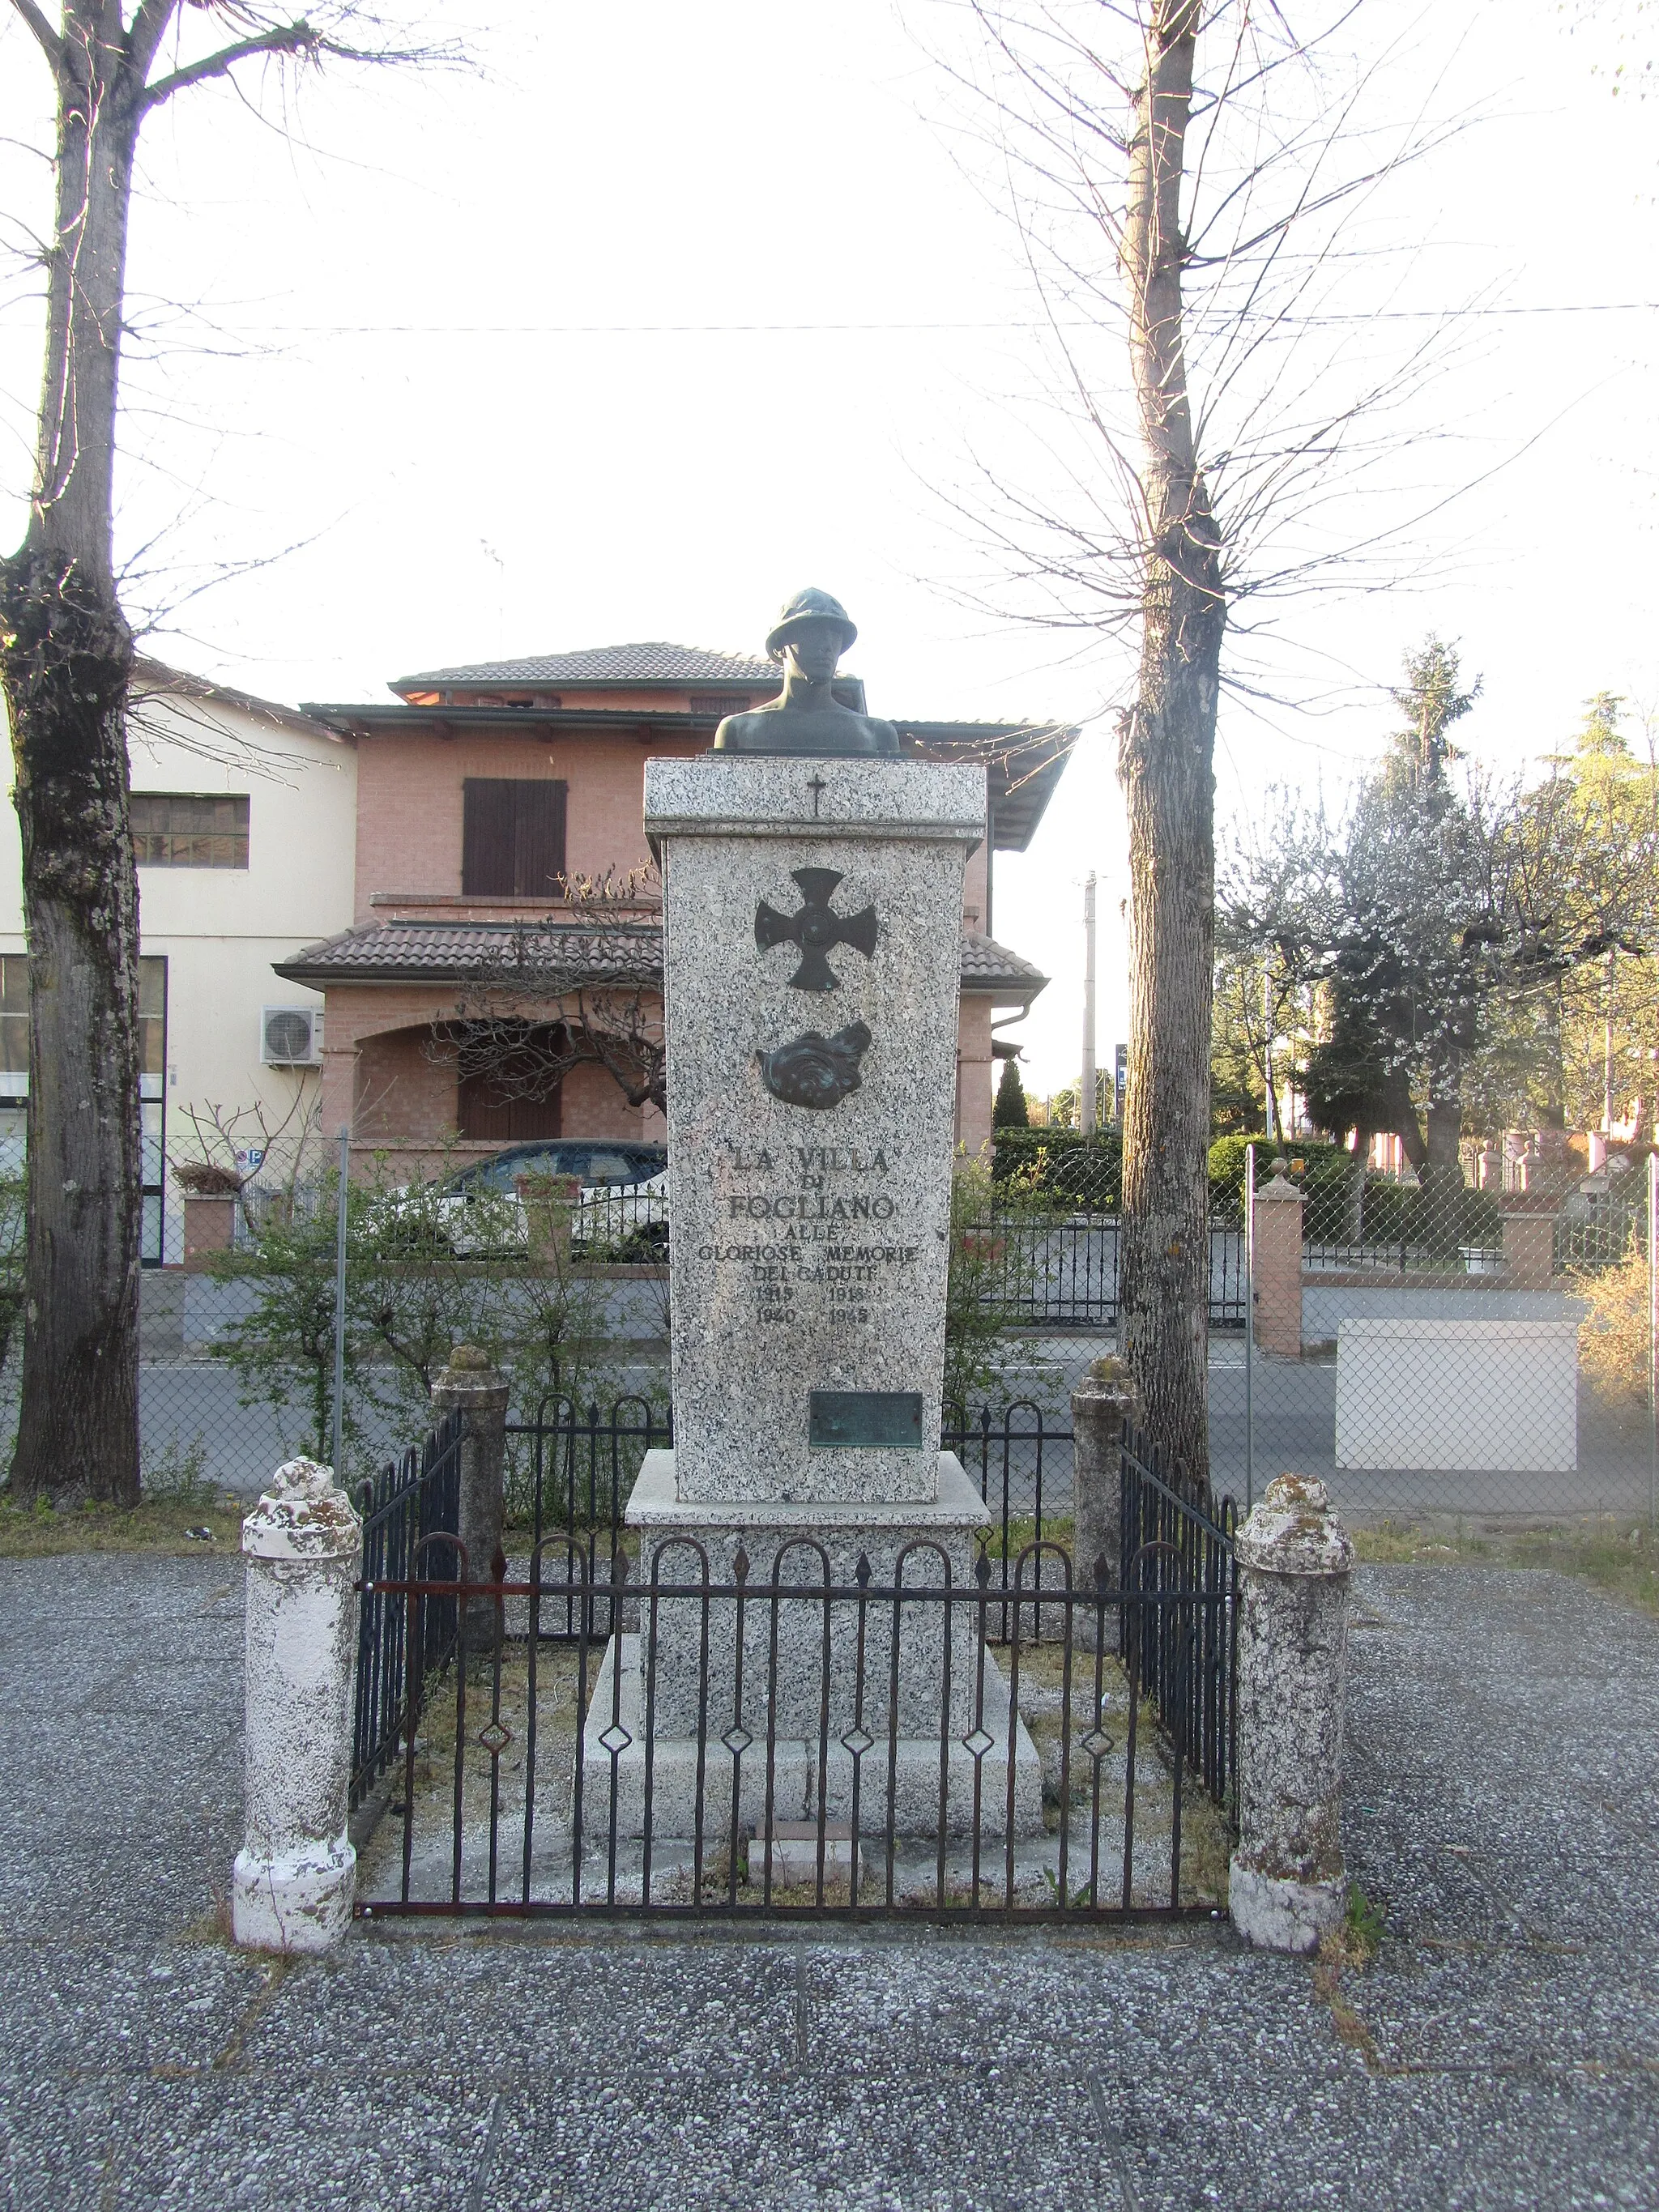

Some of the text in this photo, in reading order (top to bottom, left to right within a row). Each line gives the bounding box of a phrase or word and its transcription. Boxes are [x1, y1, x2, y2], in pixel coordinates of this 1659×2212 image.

[733, 1146, 889, 1170] LA VILLA
[802, 1174, 823, 1190] DI
[729, 1195, 895, 1219] FOGLIANO
[783, 1223, 839, 1240] ALLE
[698, 1246, 919, 1262] GLORIOSE MEMORIE
[753, 1266, 789, 1282] DEI
[755, 1286, 864, 1302] 1915 1918
[756, 1307, 868, 1324] 1940 1945
